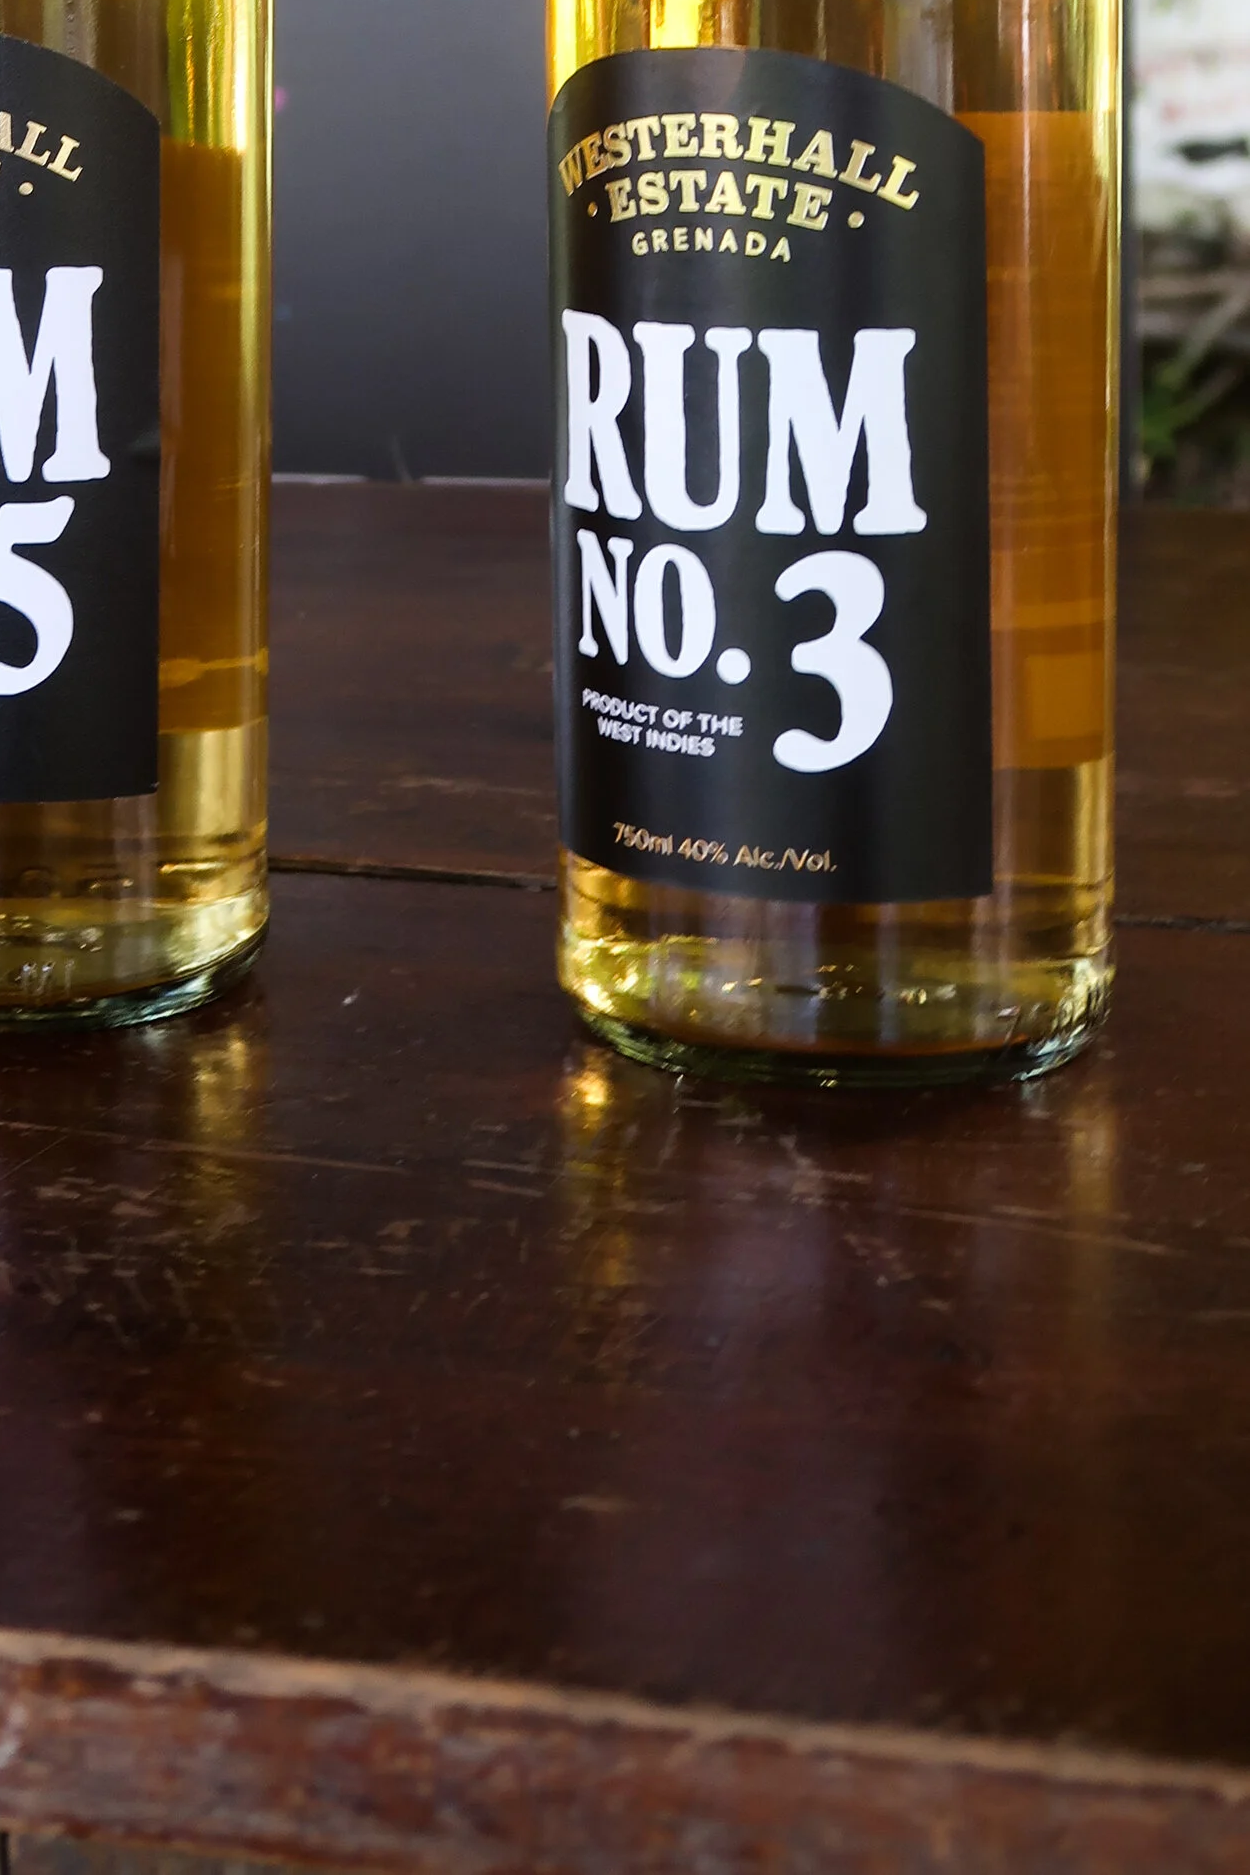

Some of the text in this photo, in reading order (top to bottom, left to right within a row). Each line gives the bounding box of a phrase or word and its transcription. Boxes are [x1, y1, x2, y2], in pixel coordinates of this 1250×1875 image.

[557, 112, 920, 211] WESTERHALL
[604, 168, 834, 231] ESTATE
[631, 228, 792, 263] GRENADA
[561, 307, 928, 536] RUM
[576, 528, 894, 774] NO. 3
[582, 687, 744, 737] PRODUCT OF THE
[597, 716, 716, 758] WEST INDIES
[612, 821, 674, 856] 750ml
[677, 837, 730, 866] 40%
